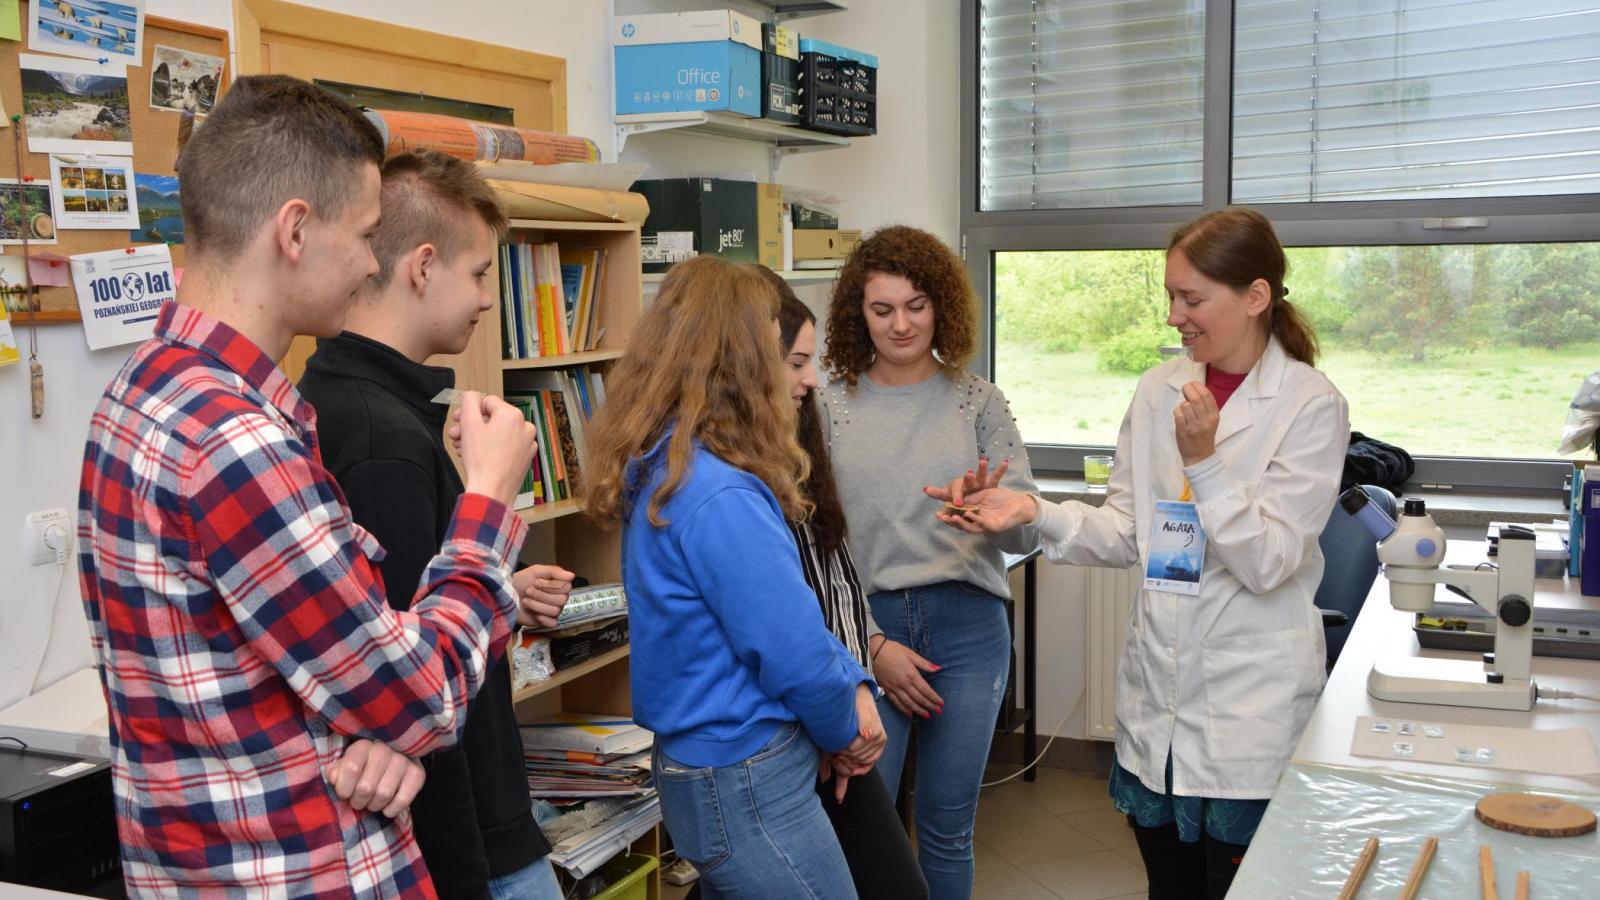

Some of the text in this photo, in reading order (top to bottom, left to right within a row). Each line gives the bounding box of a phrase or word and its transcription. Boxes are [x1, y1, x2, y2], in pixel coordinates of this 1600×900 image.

[677, 67, 720, 85] Office
[718, 228, 733, 253] jet
[89, 270, 172, 303] 100 lat
[94, 303, 139, 319] POZNAŃSKIEJ
[1162, 520, 1195, 534] AGATA
